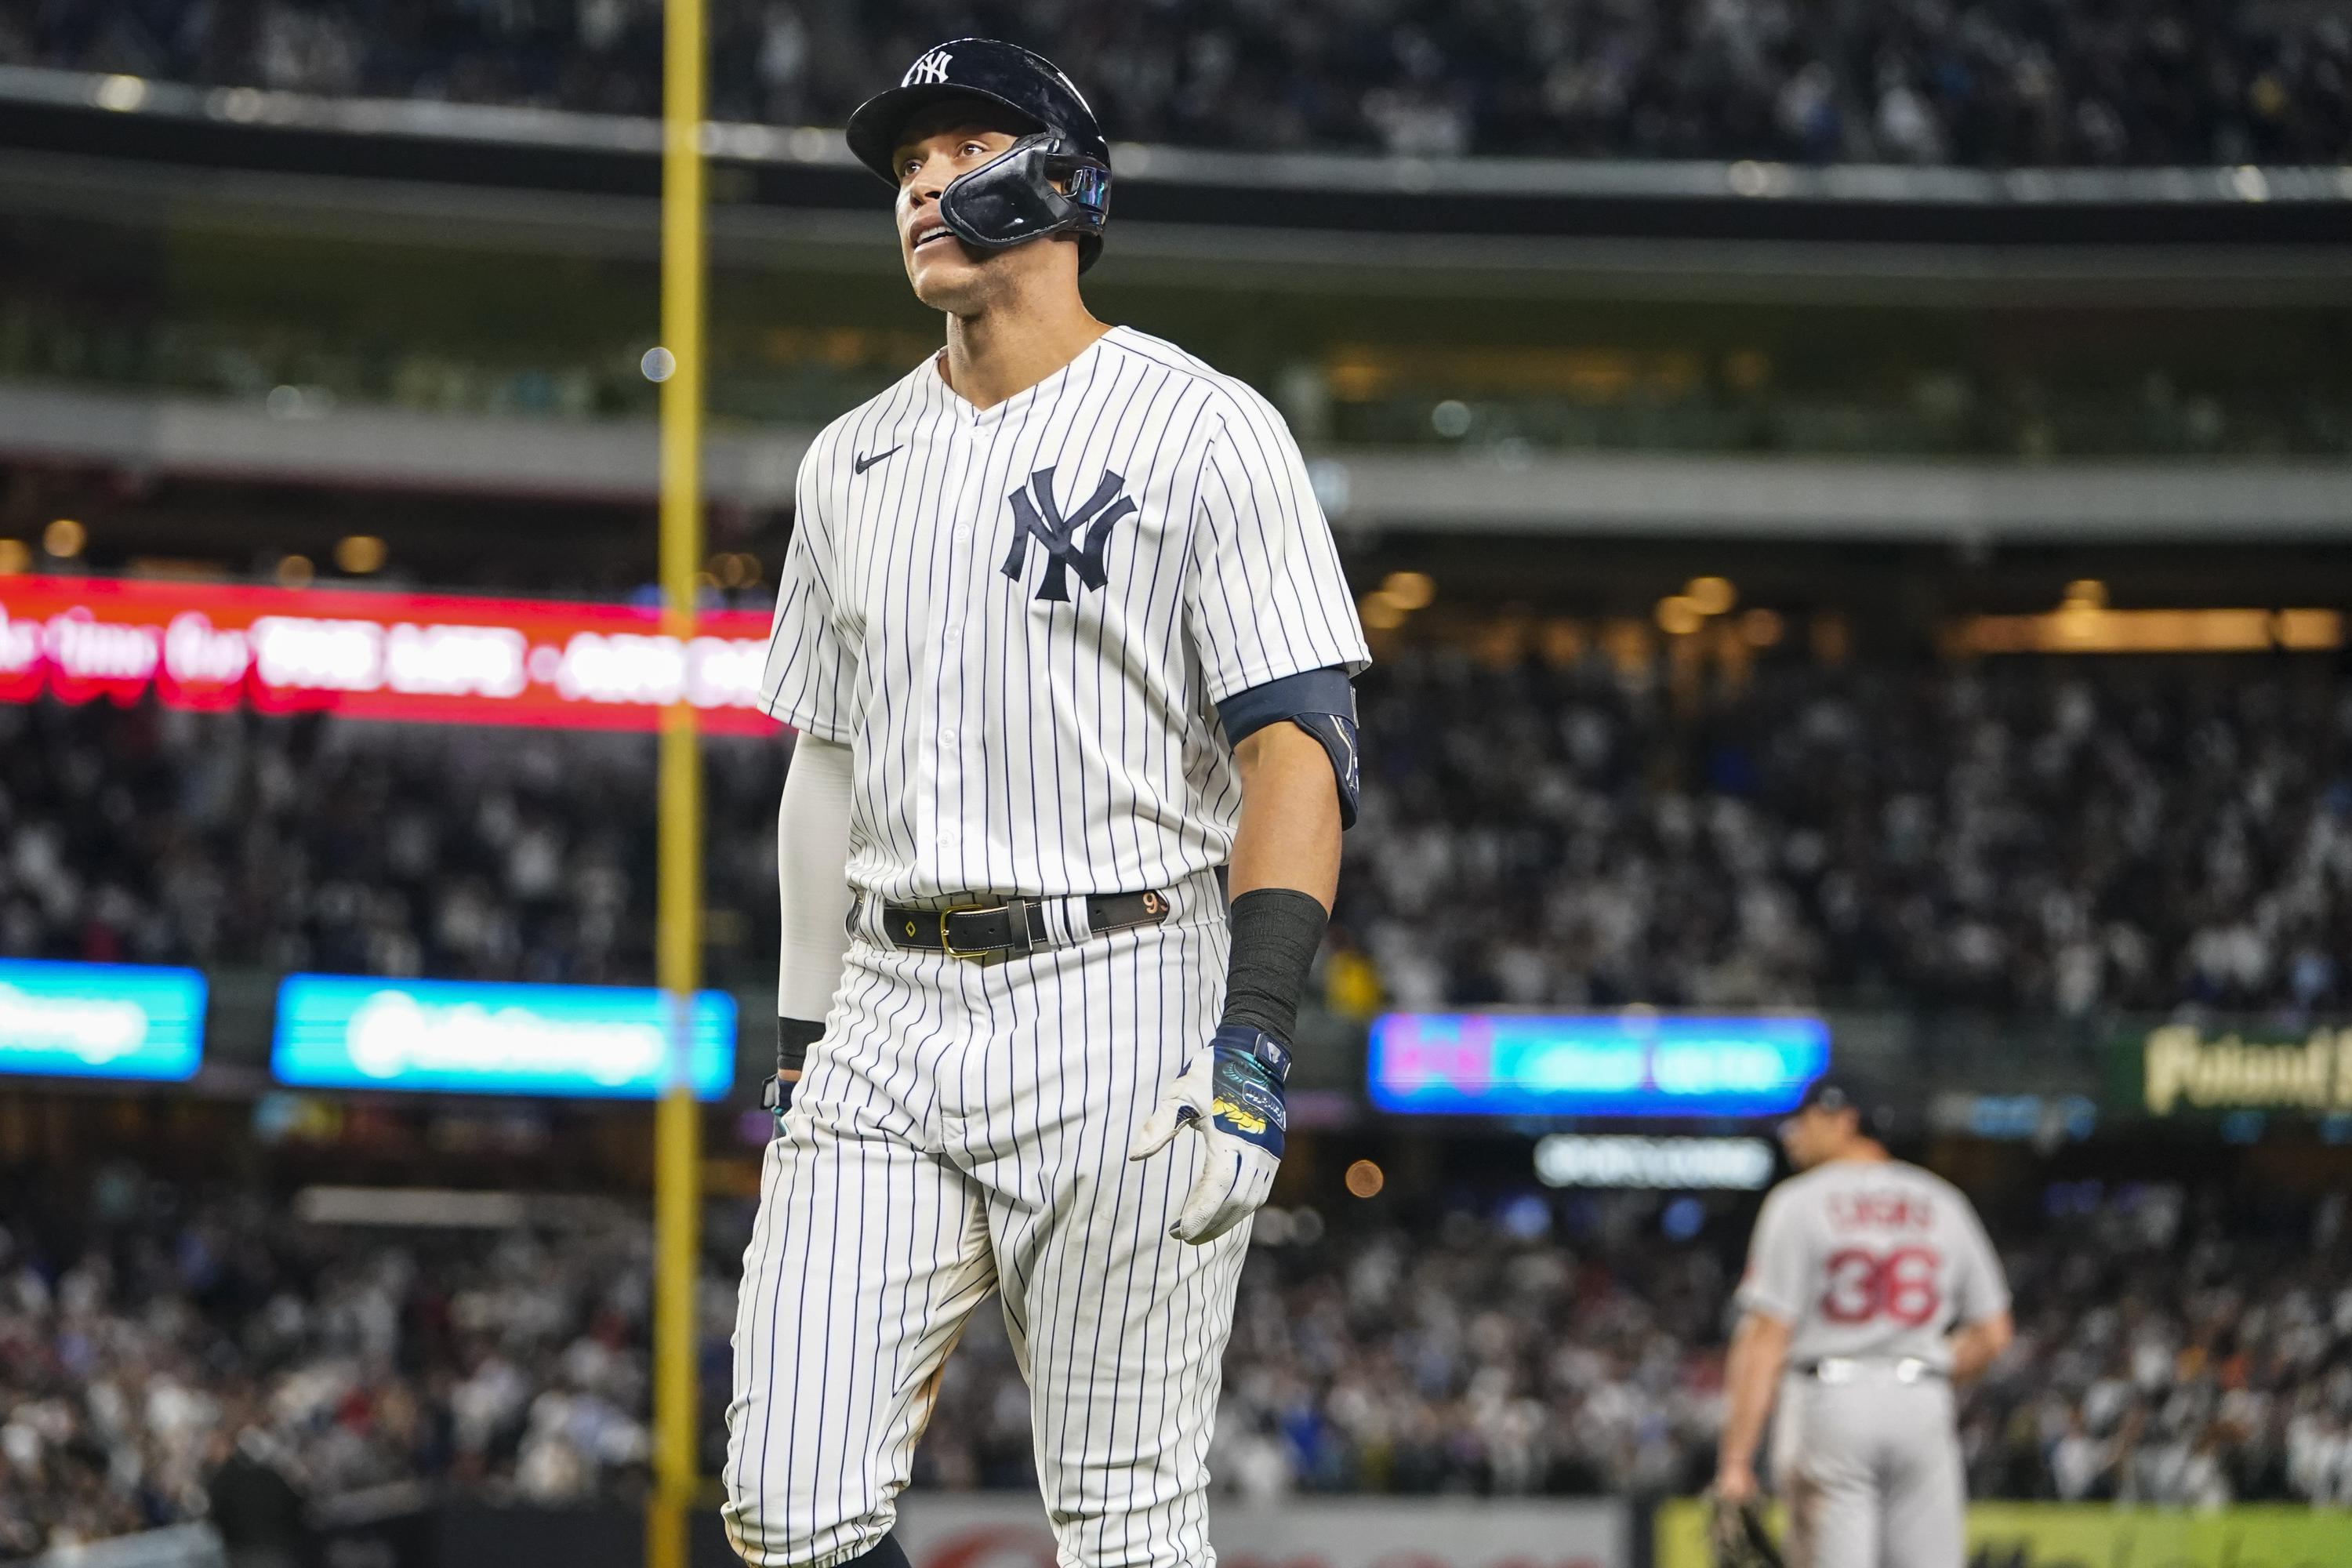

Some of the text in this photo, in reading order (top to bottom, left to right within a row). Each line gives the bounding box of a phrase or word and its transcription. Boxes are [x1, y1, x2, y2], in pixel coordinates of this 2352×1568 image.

[913, 50, 953, 85] NY
[1000, 466, 1138, 602] NY
[1142, 892, 1168, 913] 9
[1820, 1244, 1941, 1327] 36
